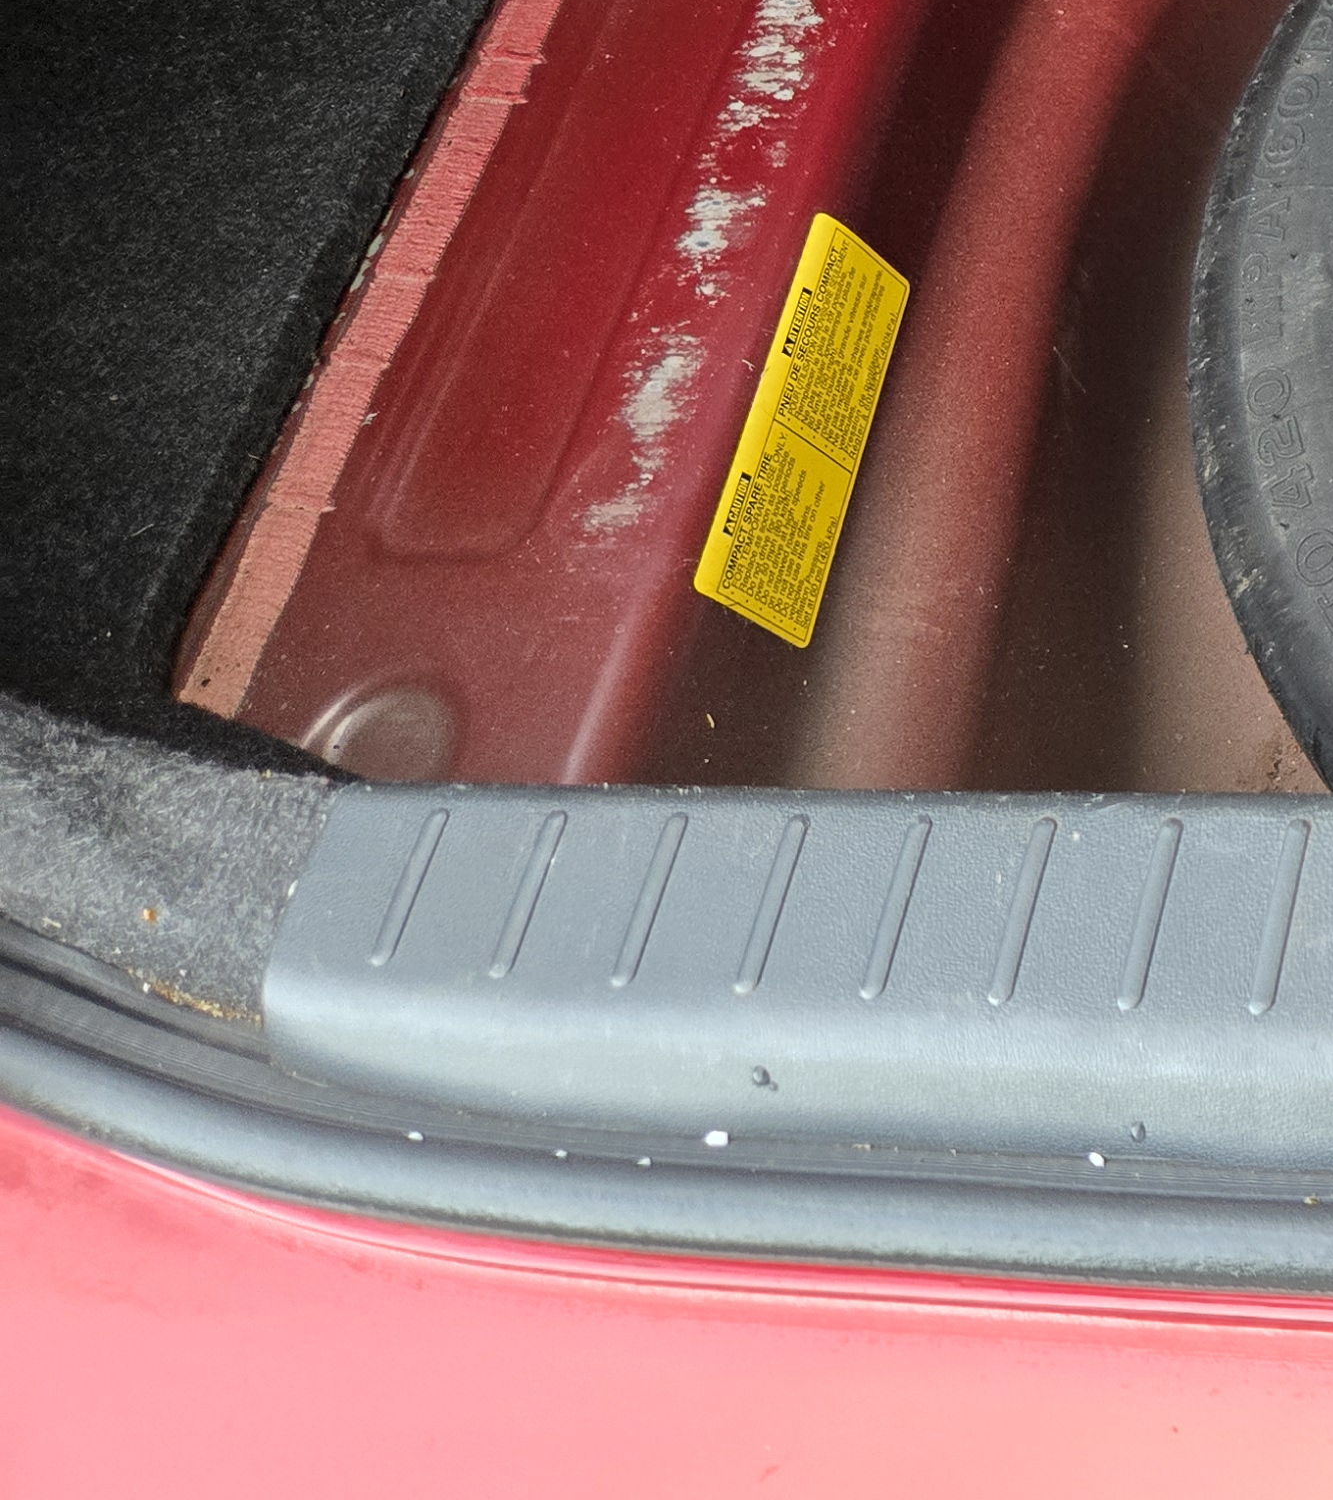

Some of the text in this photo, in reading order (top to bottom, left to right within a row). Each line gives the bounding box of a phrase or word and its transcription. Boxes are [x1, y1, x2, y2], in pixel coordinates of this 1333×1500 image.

[777, 244, 839, 418] PNEU DE SECOURS COMPACT
[787, 289, 810, 343] ATTENTION
[1230, 363, 1331, 519] 420
[721, 450, 773, 591] COMPACT SPARE TIRE
[727, 475, 750, 523] CAUTION
[731, 429, 788, 589] FOR TEMPORARY USE ONLY.
[738, 547, 759, 594] Replace
[745, 578, 756, 597] Do
[751, 560, 762, 580] not
